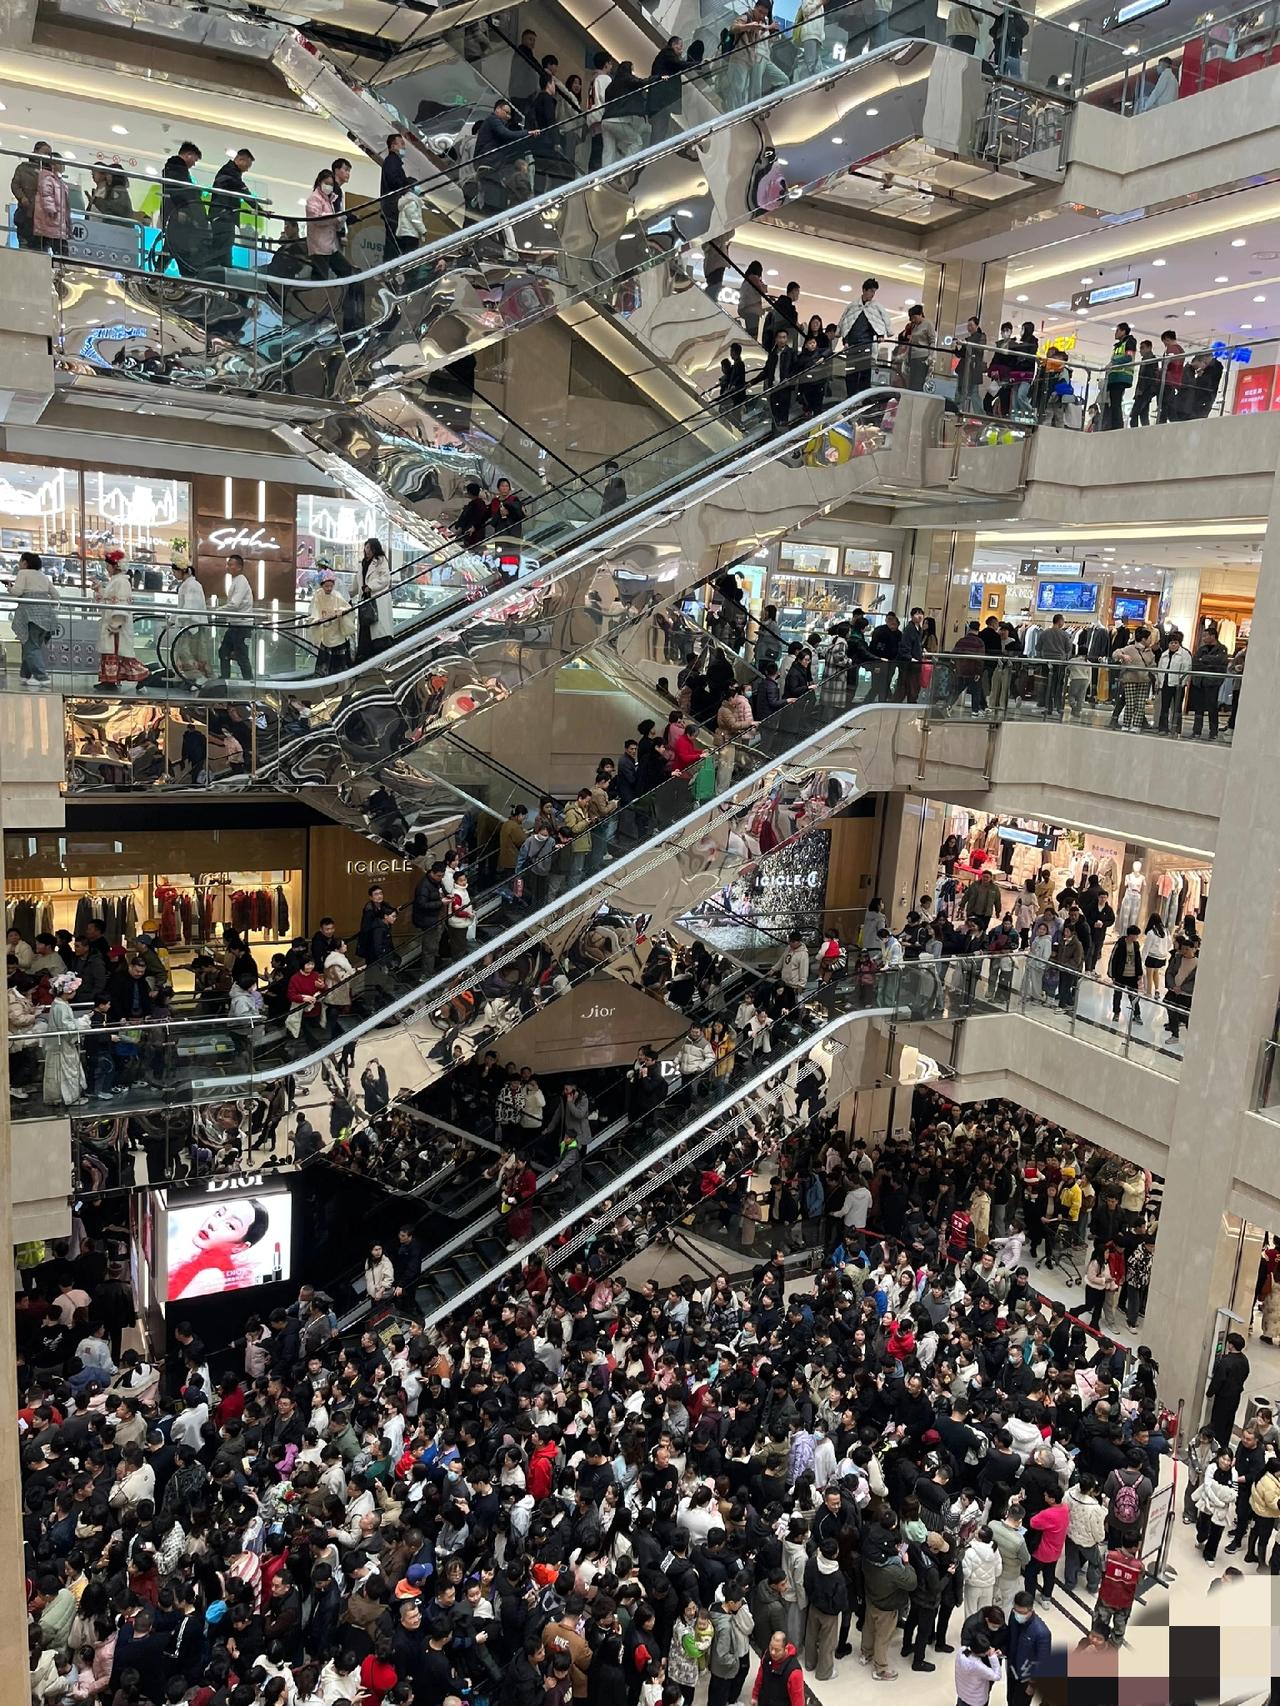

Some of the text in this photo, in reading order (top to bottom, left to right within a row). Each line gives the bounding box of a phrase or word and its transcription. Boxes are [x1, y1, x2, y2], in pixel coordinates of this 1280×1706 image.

[72, 226, 86, 239] 4F
[347, 859, 413, 874] ICICLE
[755, 874, 802, 887] ICICLE
